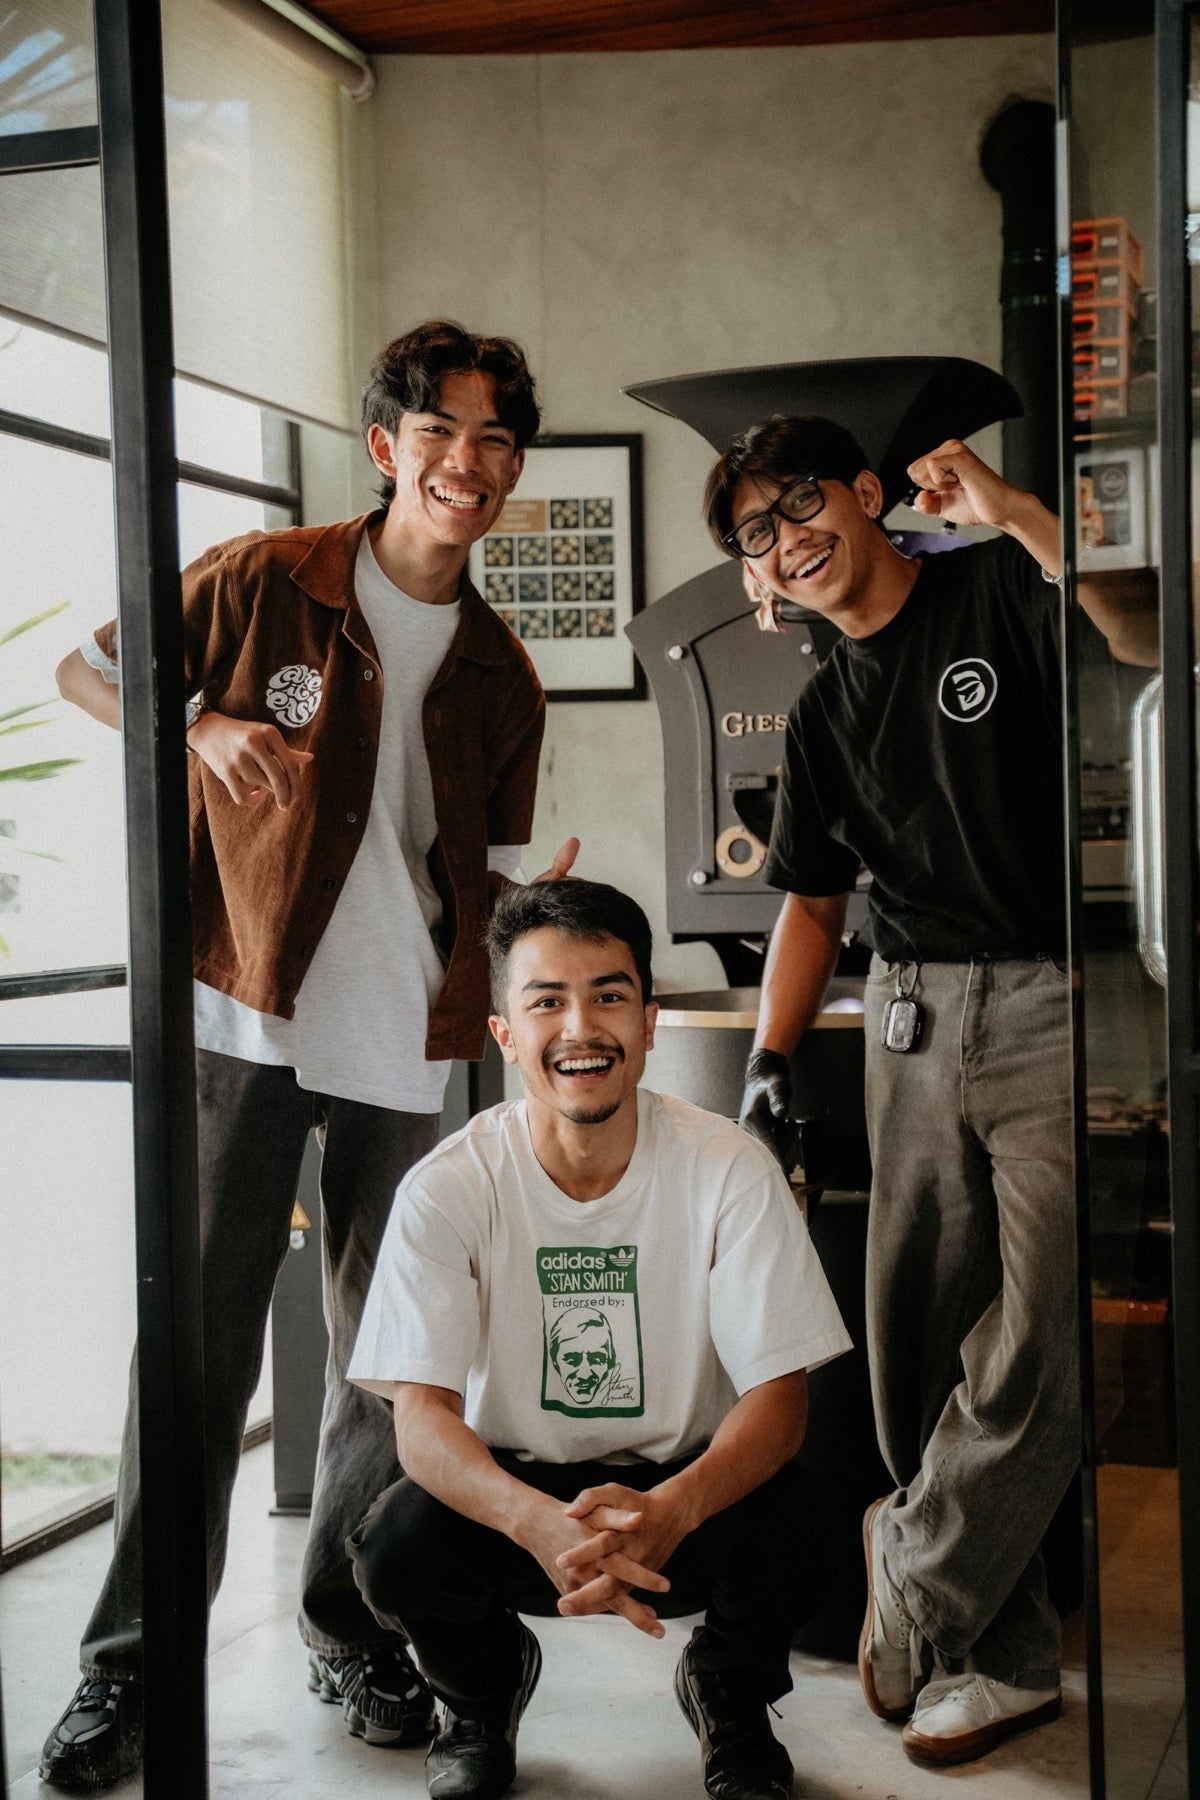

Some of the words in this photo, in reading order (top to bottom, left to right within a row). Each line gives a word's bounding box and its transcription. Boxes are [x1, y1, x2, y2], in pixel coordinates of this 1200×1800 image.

[283, 683, 309, 701] it
[540, 1252, 606, 1270] adidas
[552, 1297, 605, 1308] Endorsed
[607, 1296, 625, 1308] by:
